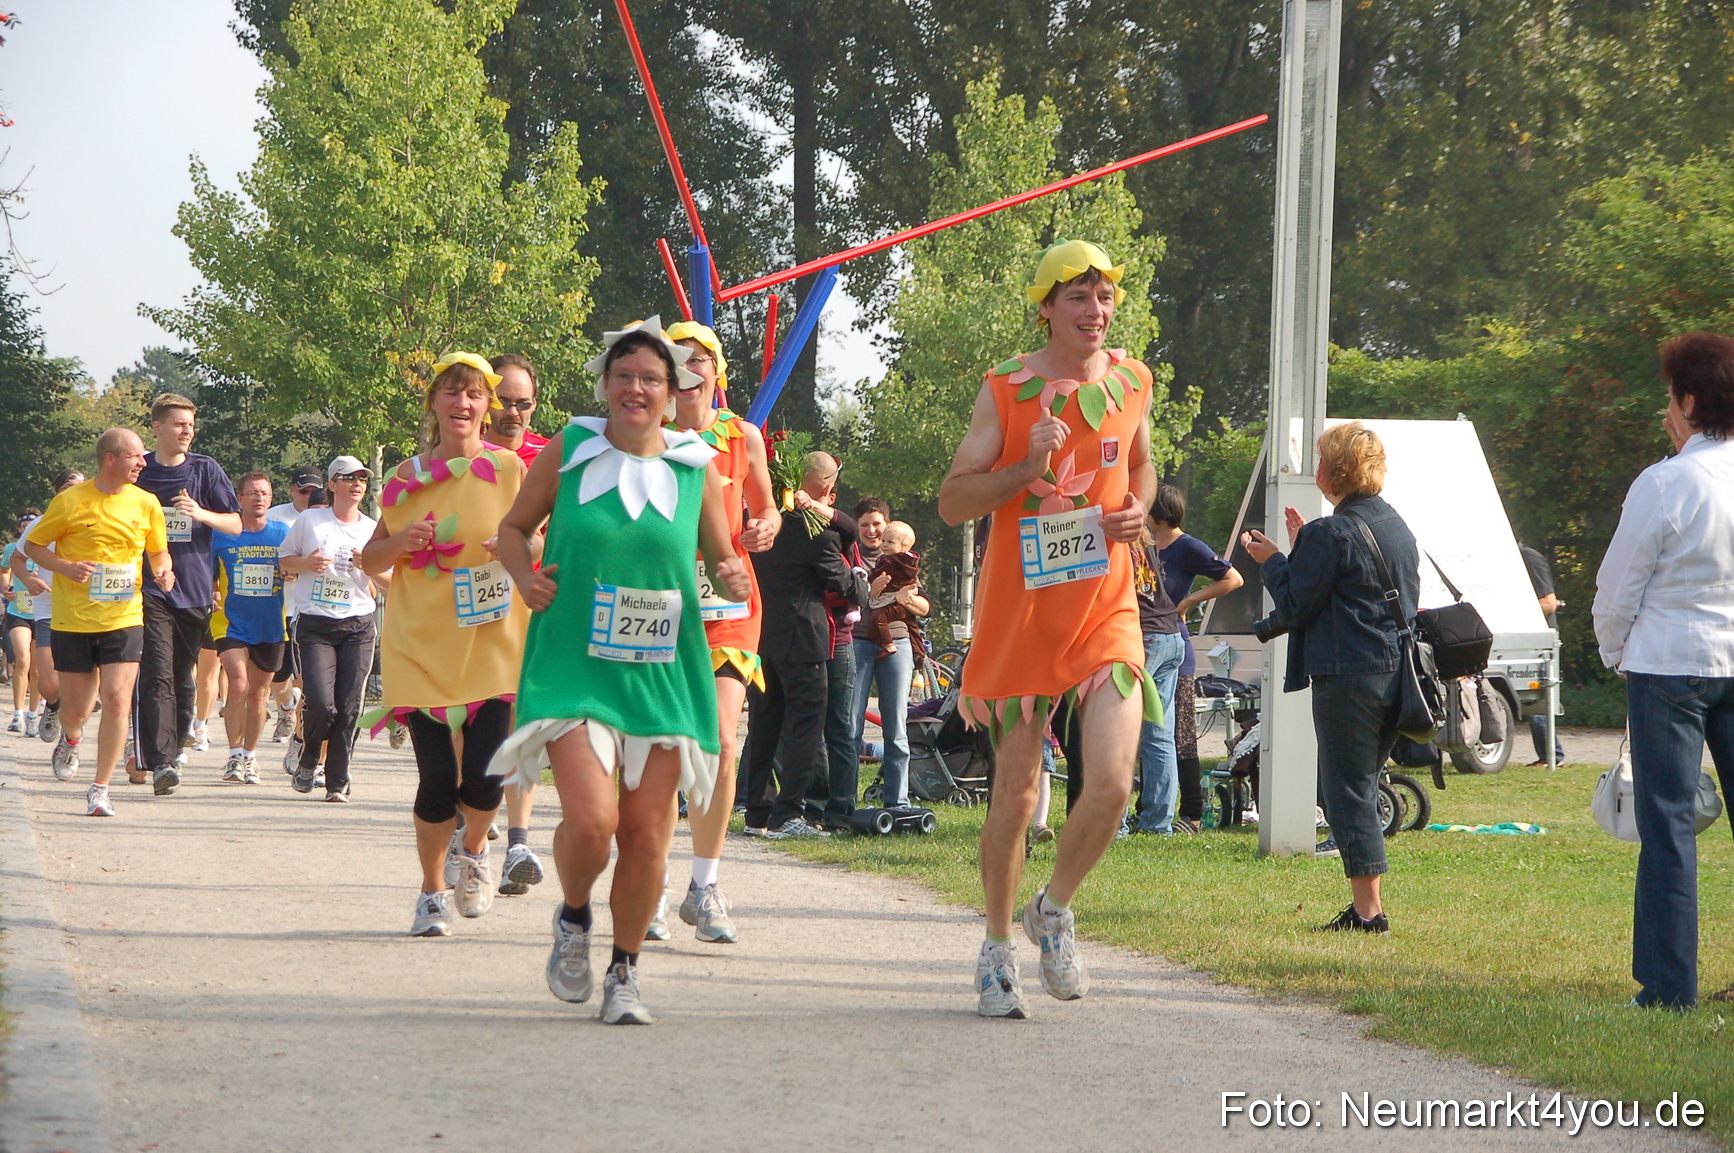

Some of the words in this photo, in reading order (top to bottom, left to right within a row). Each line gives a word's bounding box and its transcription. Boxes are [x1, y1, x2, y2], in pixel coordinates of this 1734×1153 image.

[166, 521, 187, 530] 479
[1043, 521, 1076, 535] Reiner
[1026, 544, 1032, 553] C
[1047, 533, 1096, 560] 2872
[237, 551, 277, 559] STADTLAUF
[245, 576, 269, 585] 3810
[474, 569, 491, 582] Gabi
[105, 578, 131, 589] 2633
[324, 588, 350, 600] 3478
[460, 590, 465, 598] C
[477, 579, 510, 604] 2454
[621, 594, 667, 610] Michaela
[618, 616, 671, 637] 2740
